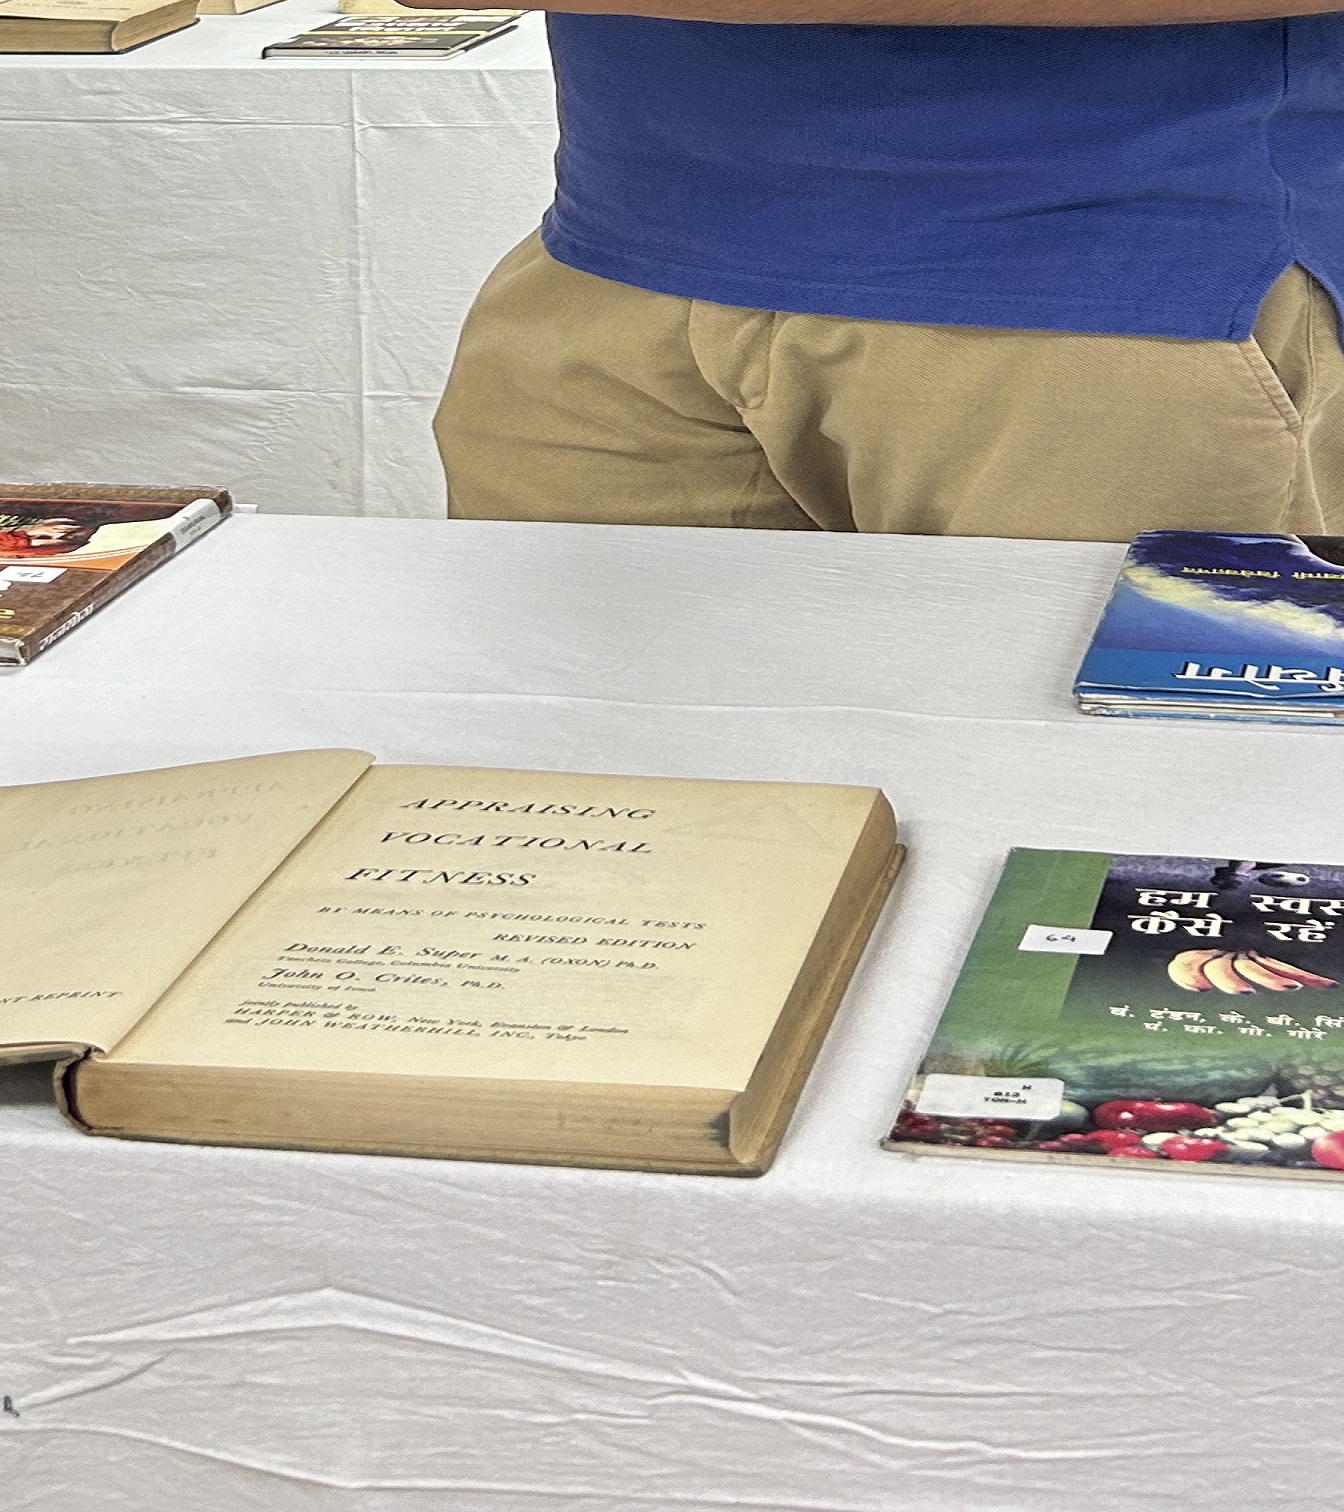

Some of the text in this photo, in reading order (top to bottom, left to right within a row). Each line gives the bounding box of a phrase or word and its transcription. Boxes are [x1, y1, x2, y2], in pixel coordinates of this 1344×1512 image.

[400, 797, 656, 820] APPRAISING
[379, 830, 654, 855] VOCATIONAL
[344, 866, 538, 888] FITNESS
[1134, 887, 1219, 912] हम
[317, 905, 707, 931] BY MEANS OF PSYCHOLOGICAL TESTS
[1127, 909, 1235, 939] कैसे
[1265, 915, 1338, 944] रहें
[491, 932, 697, 951] REVISED EDITION
[283, 942, 660, 970] Donald E. Super M. A. (OXON) Ph.D.
[390, 960, 452, 969] Columbia
[456, 963, 521, 973] University
[258, 981, 322, 991] University
[327, 984, 341, 992] of
[262, 967, 505, 990] John O. Crites, Ph.D.
[28, 989, 123, 1002] REPRINT
[285, 1001, 359, 1012] published by
[224, 1017, 252, 1025] and
[254, 1017, 318, 1027] JOHN
[323, 1020, 482, 1038] WEATHERHILL,
[545, 1031, 588, 1042] Tokyo
[233, 1007, 317, 1018] HARPER
[347, 1013, 397, 1023] ROW,
[410, 1016, 441, 1025] New
[446, 1018, 483, 1028] York,
[578, 1025, 629, 1034] London
[1287, 1026, 1329, 1041] गोरे
